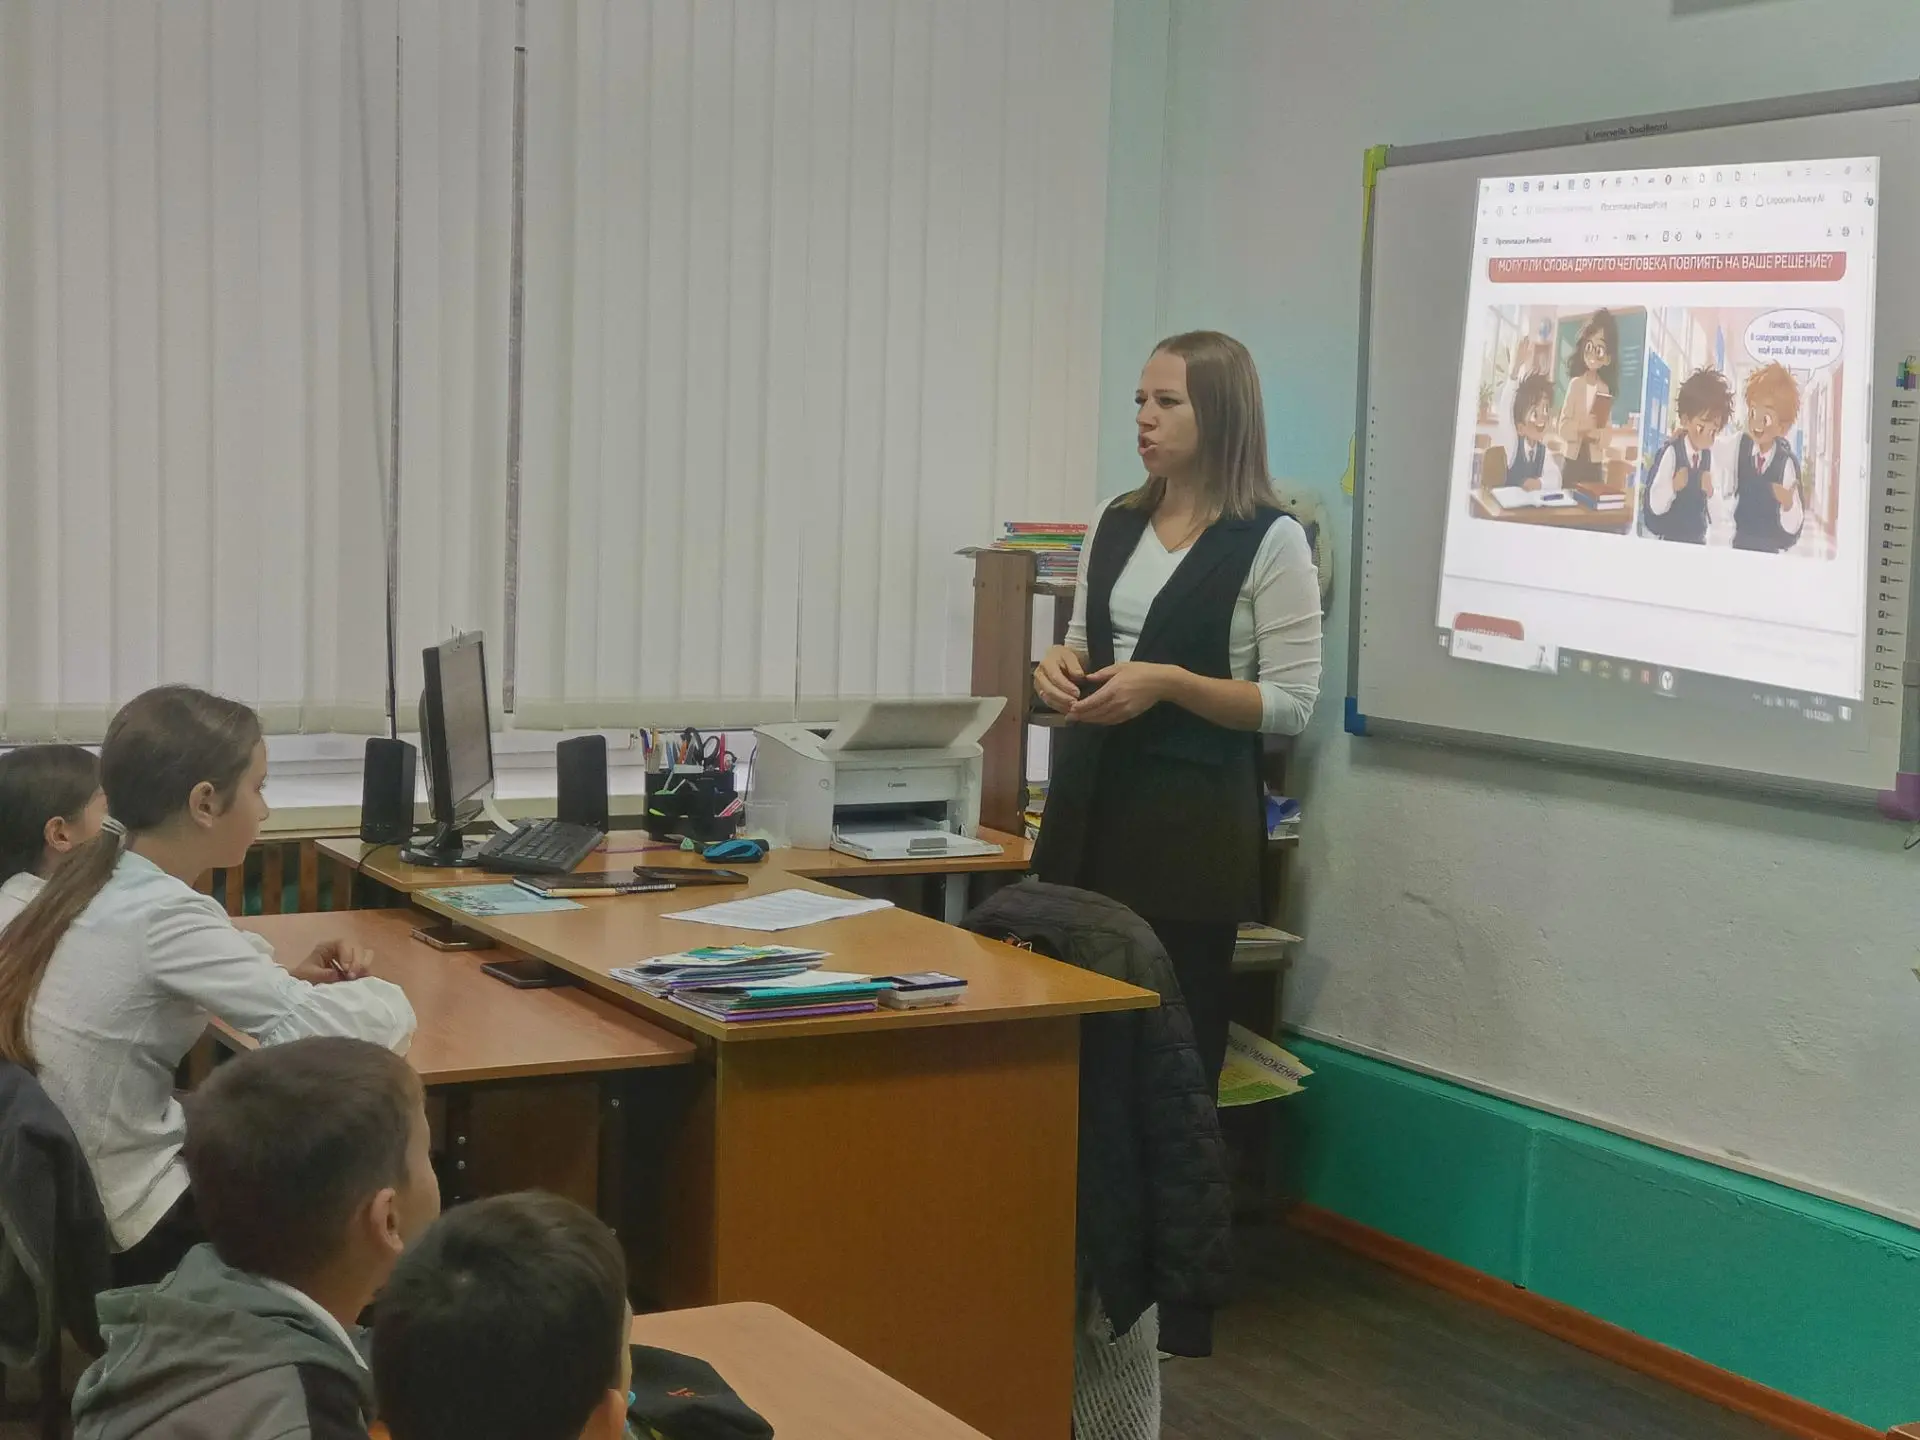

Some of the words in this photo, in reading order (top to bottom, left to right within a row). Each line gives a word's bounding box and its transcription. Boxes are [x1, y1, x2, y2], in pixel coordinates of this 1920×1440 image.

[1499, 259, 1528, 273] МОГУТ
[1528, 258, 1542, 273] ЛИ
[1543, 258, 1573, 271] СЛОВА
[1575, 257, 1616, 273] ДРУГОГО
[1617, 256, 1667, 270] ЧЕЛОВЕКА
[1669, 256, 1723, 270] ПОВЛИЯТЬ
[1725, 256, 1740, 269] НА
[1742, 255, 1773, 269] ВАШЕ
[1774, 254, 1834, 269] РЕШЕНИЕ?
